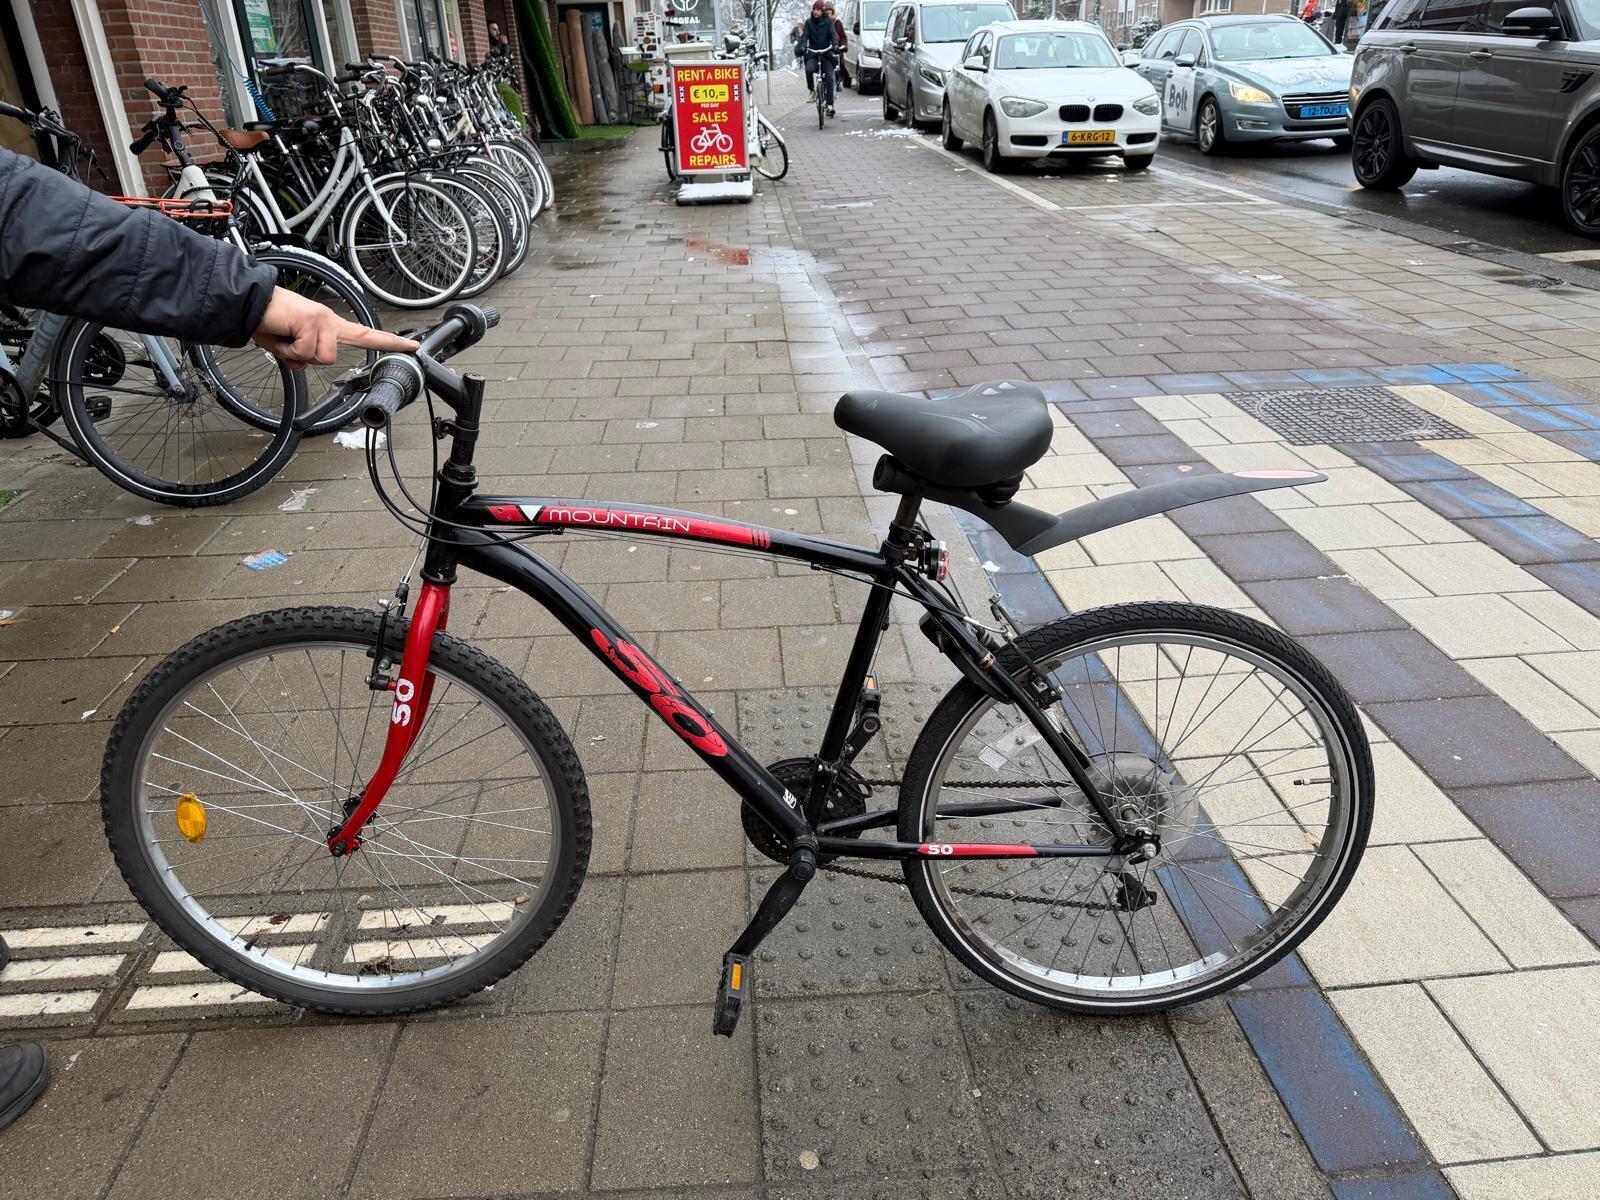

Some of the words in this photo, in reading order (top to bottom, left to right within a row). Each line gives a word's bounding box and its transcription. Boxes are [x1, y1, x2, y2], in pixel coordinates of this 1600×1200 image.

[677, 69, 706, 82] RENT
[714, 68, 739, 80] BIKE
[1169, 83, 1188, 113] Bolt
[692, 111, 728, 123] SALES
[1071, 132, 1111, 142] 6-KRG-12
[689, 154, 737, 166] REPAIRS
[549, 509, 691, 532] MOUNTAIN
